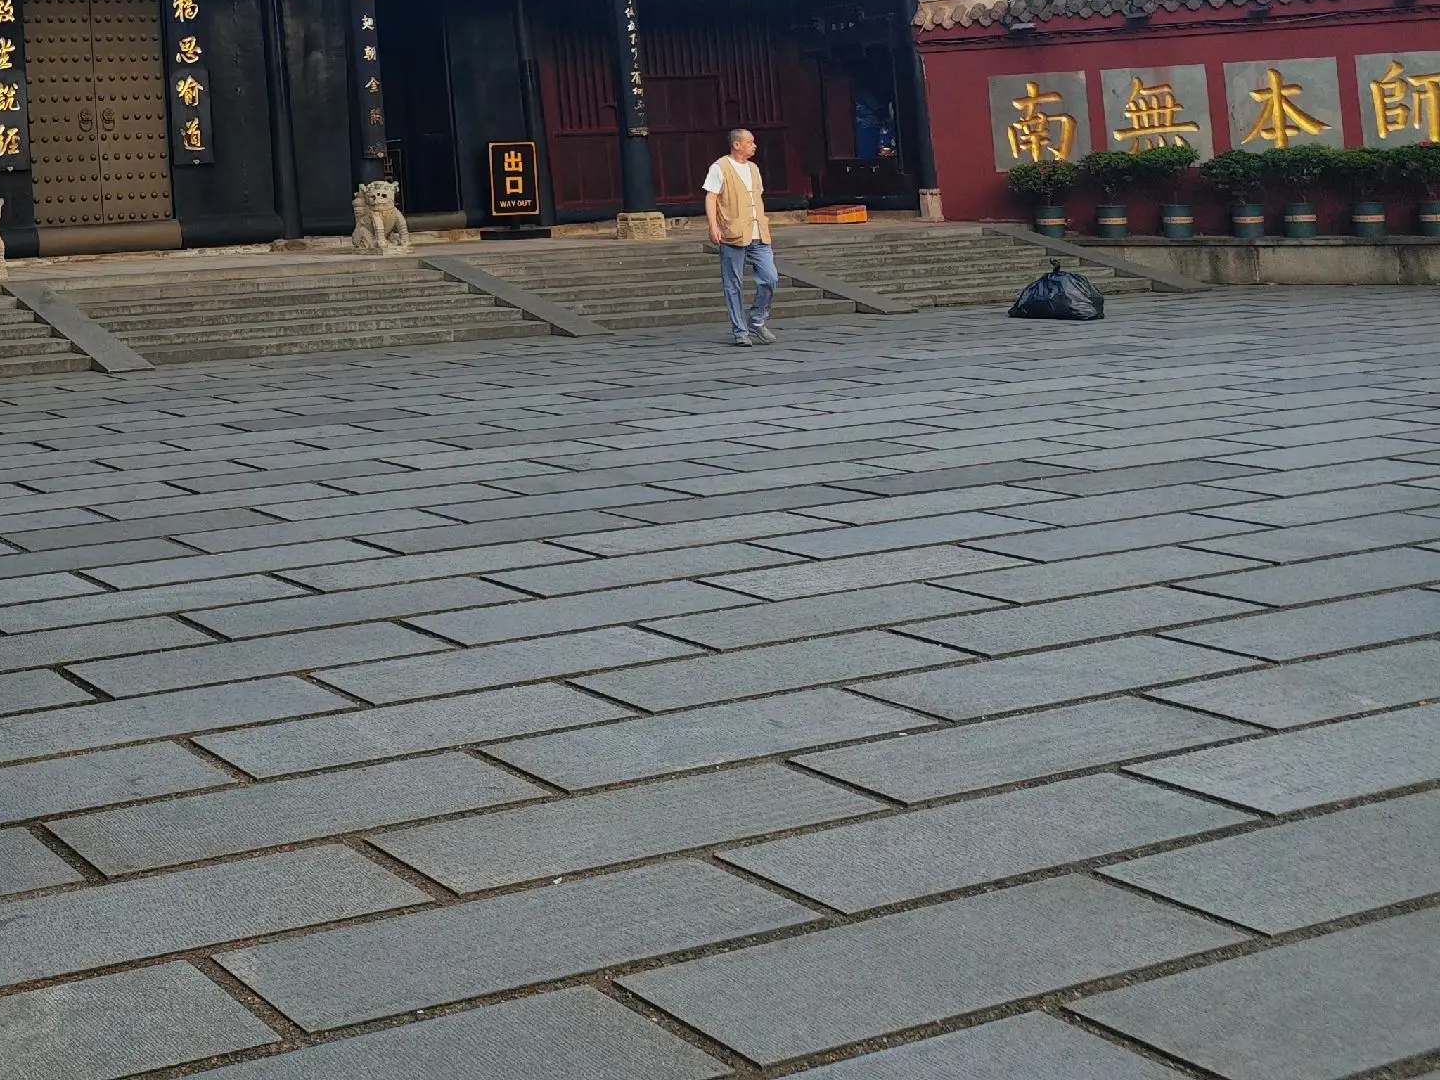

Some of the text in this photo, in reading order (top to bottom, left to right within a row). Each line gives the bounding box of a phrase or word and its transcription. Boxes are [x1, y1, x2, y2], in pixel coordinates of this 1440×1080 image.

[504, 150, 523, 195] 出口
[499, 198, 532, 208] WAY OUT
